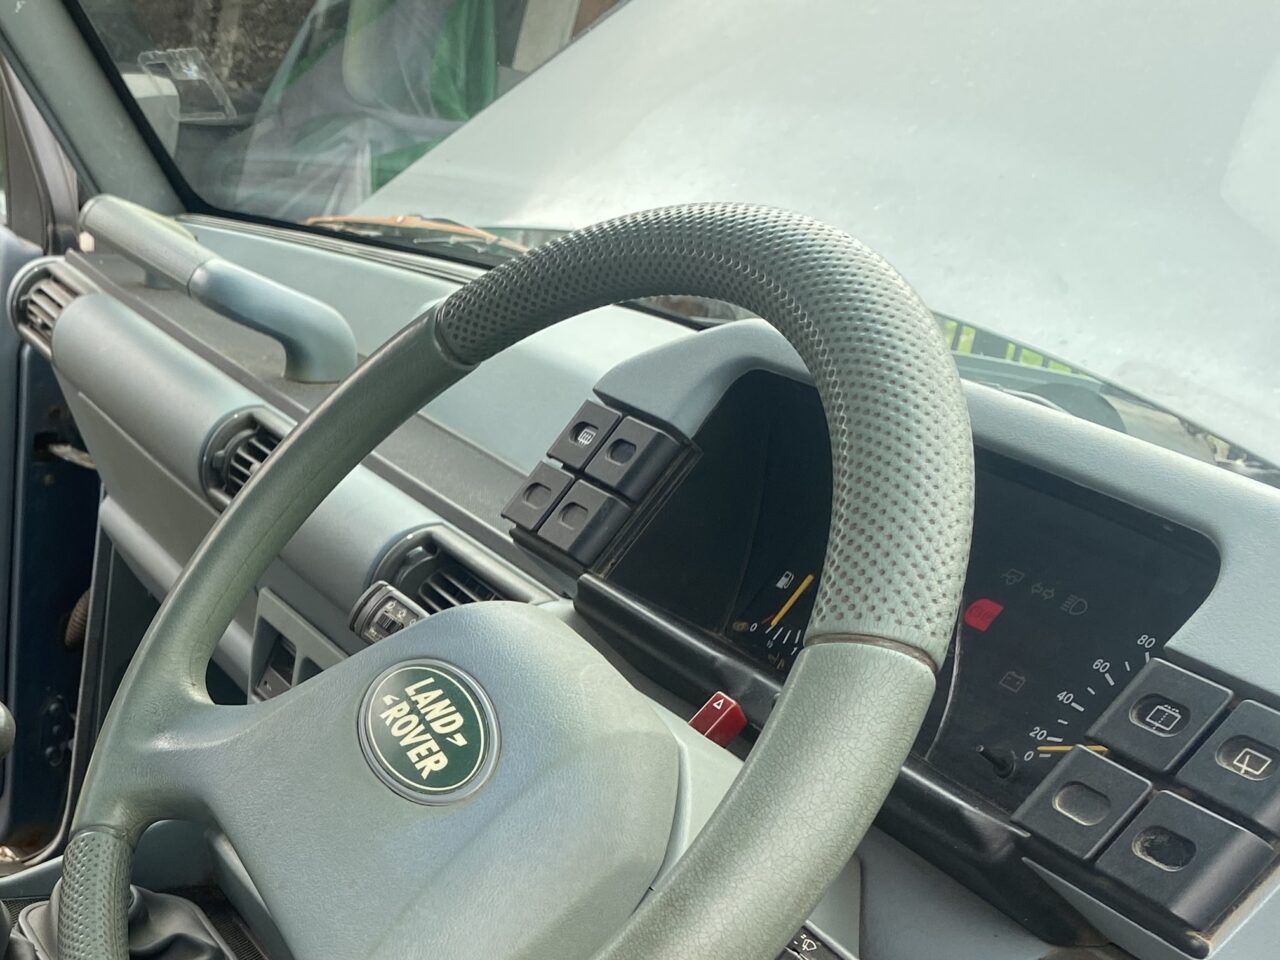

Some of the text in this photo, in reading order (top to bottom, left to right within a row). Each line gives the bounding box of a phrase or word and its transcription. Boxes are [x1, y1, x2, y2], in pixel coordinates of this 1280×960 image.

[1137, 634, 1156, 649] 80
[1092, 658, 1110, 673] 60
[1056, 691, 1074, 704] 40
[404, 677, 464, 735] LAND
[379, 700, 449, 780] ROVER
[1029, 726, 1047, 741] 20
[1023, 751, 1034, 761] 0
